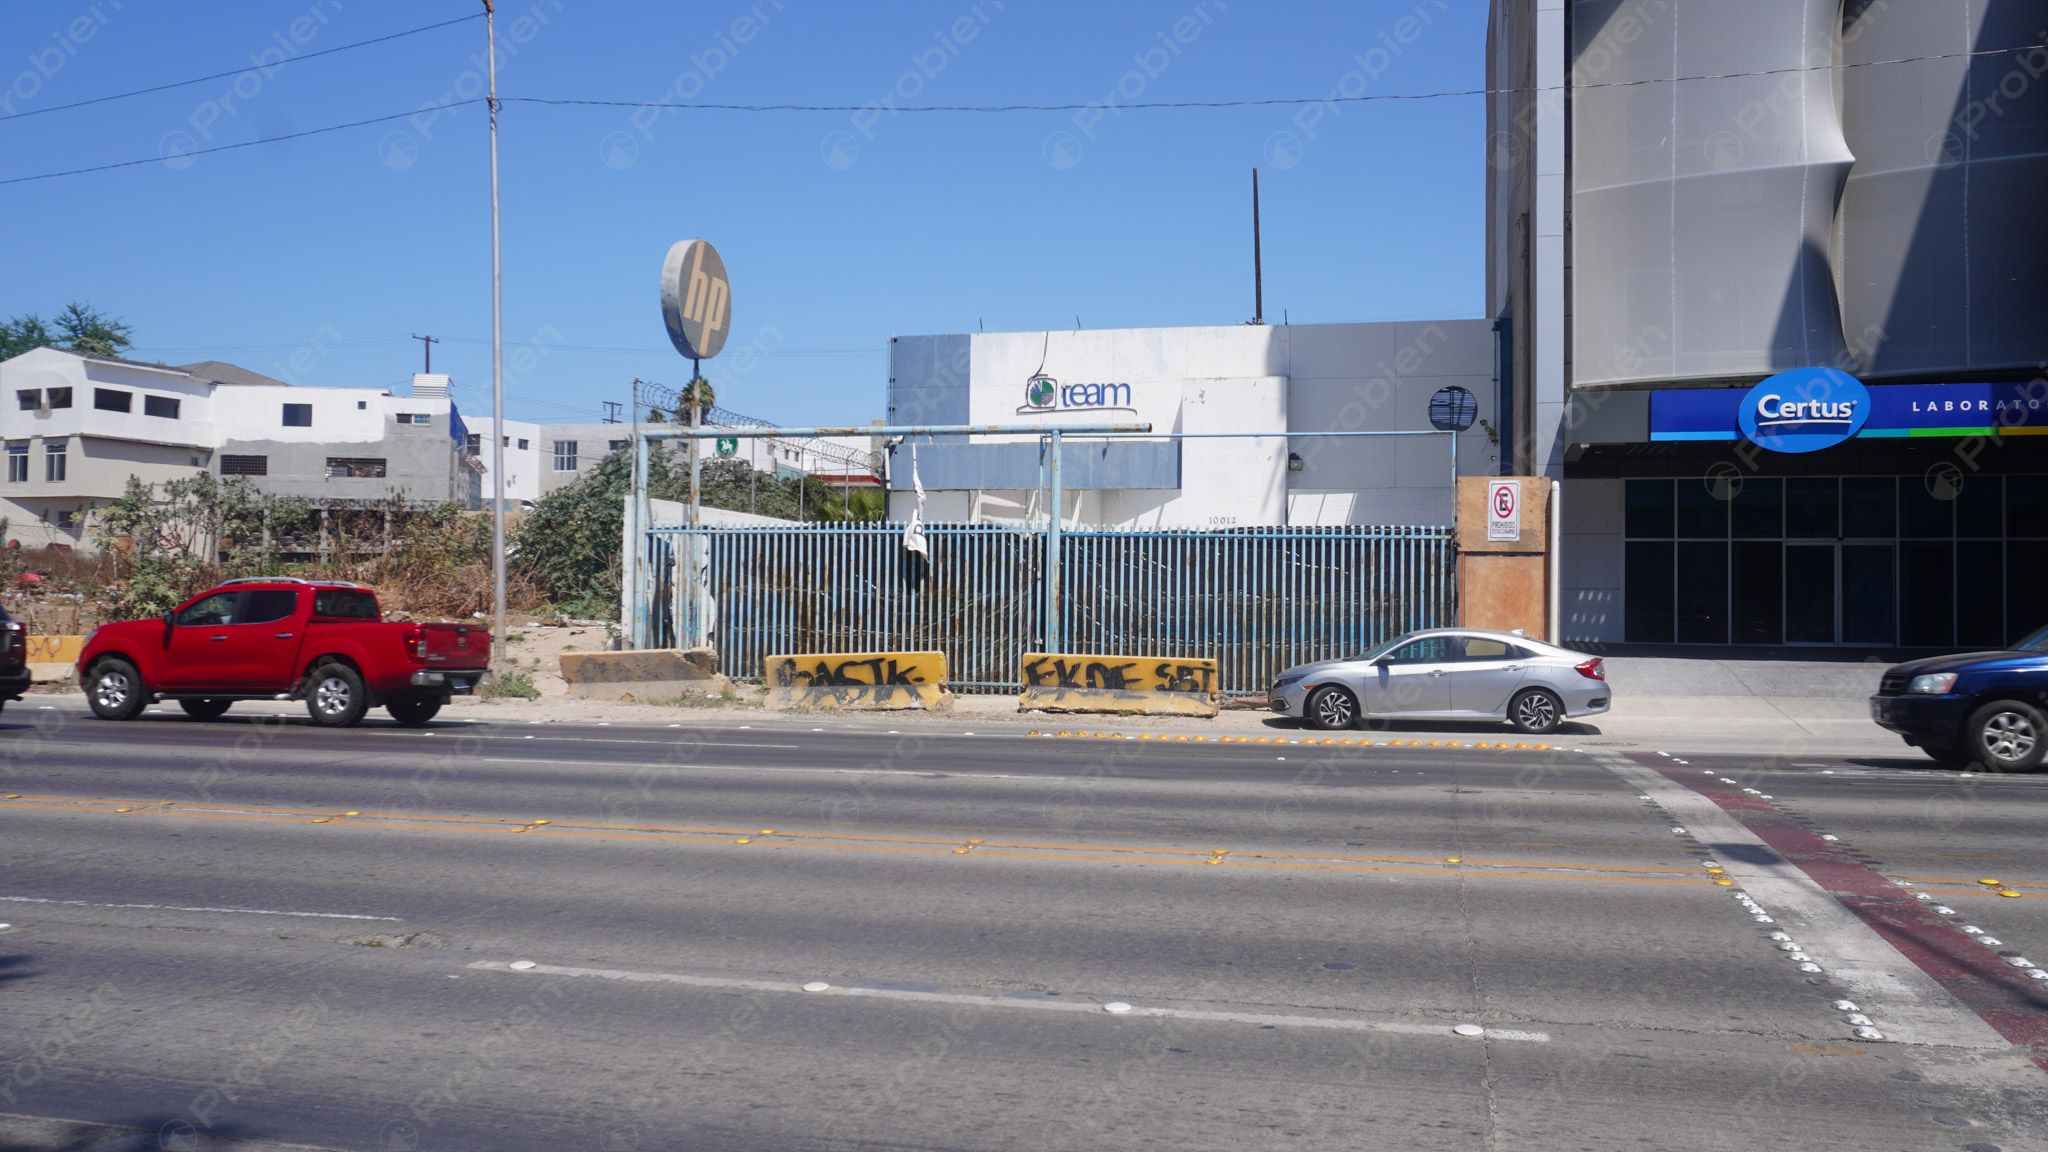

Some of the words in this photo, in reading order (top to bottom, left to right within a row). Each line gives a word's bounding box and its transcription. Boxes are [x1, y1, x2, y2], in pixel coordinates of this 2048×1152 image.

[683, 240, 728, 357] hp
[1061, 382, 1131, 408] team
[1209, 515, 1237, 525] 10012
